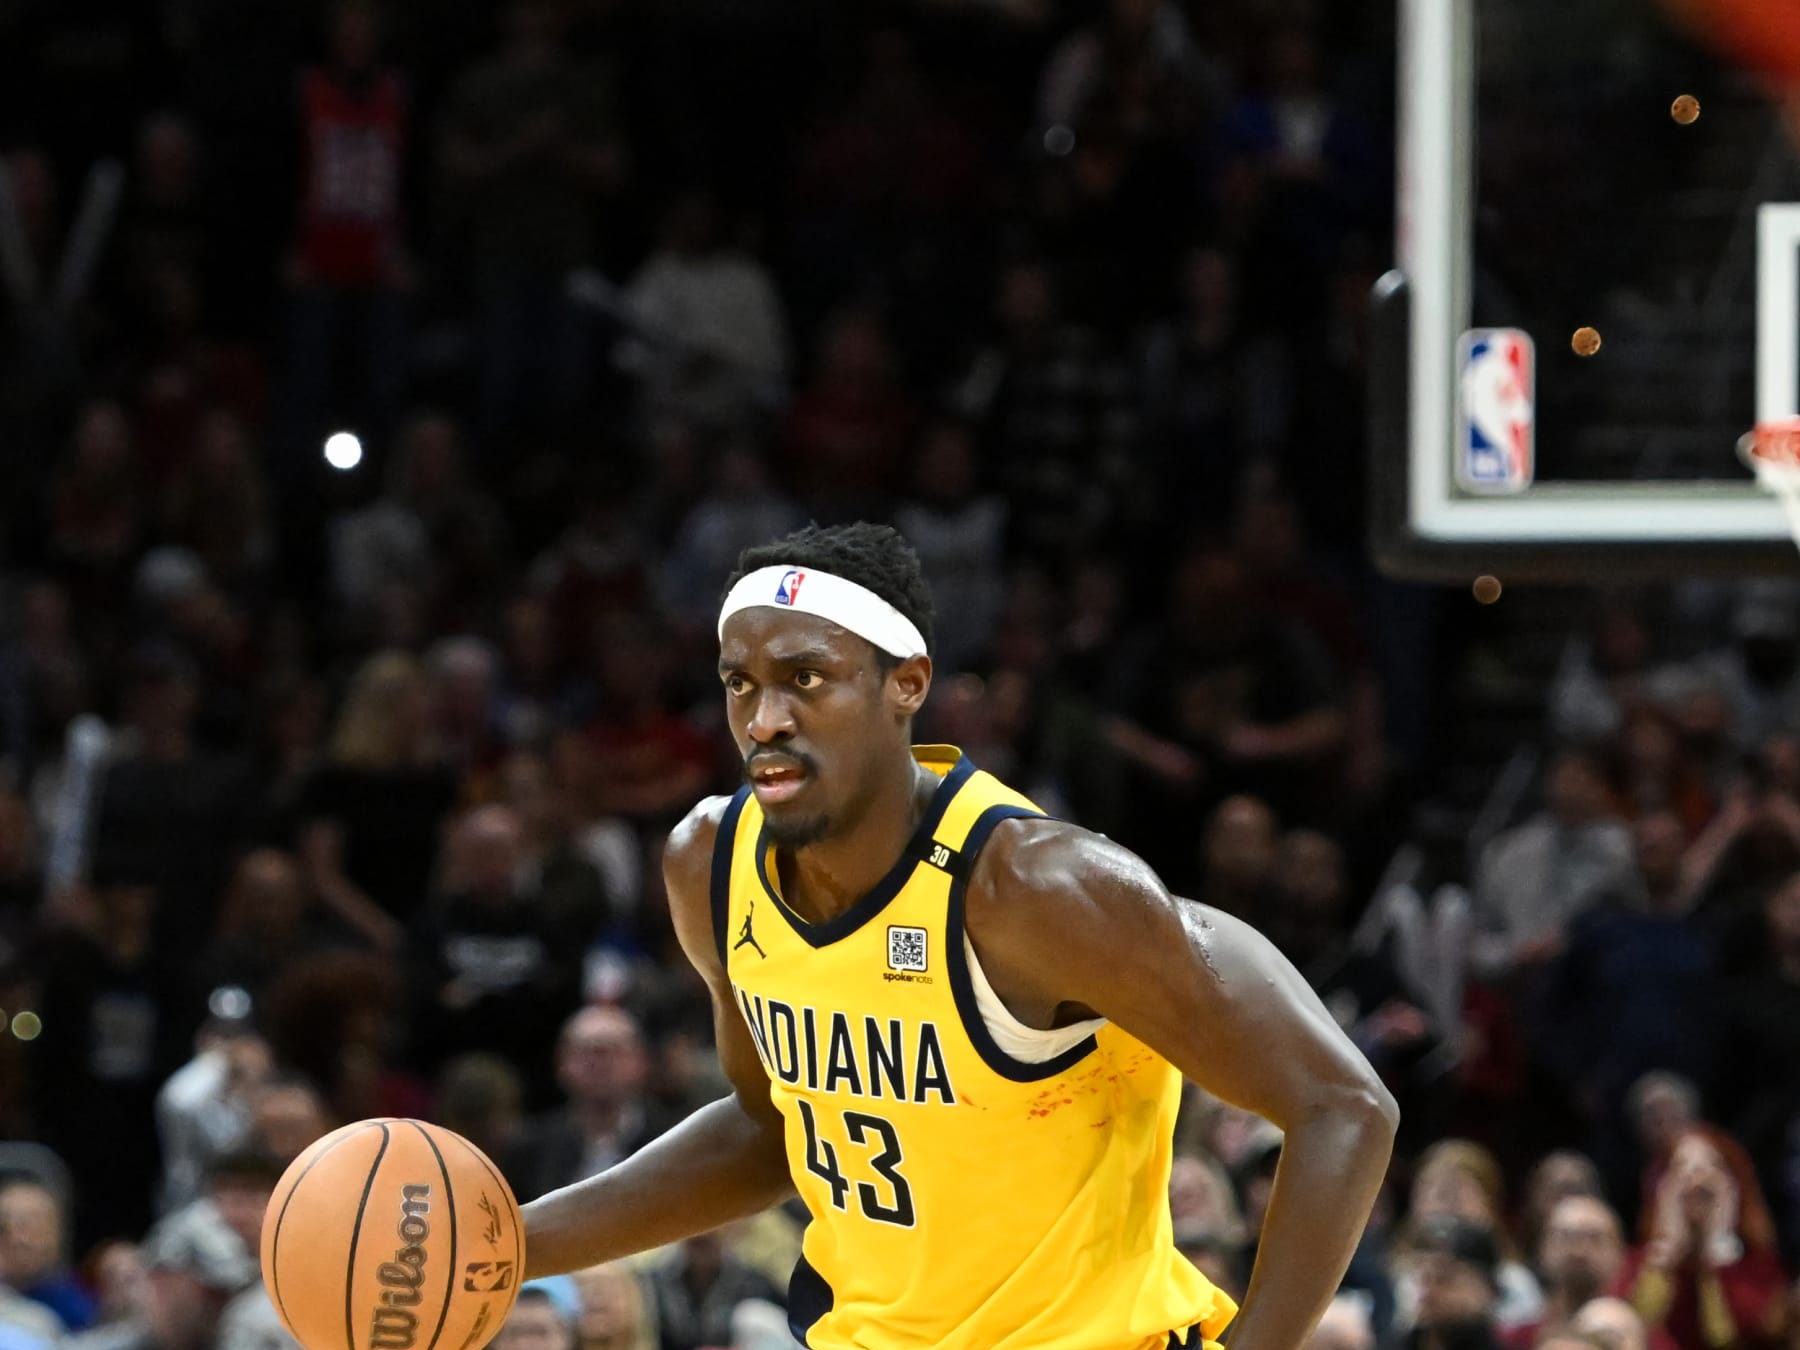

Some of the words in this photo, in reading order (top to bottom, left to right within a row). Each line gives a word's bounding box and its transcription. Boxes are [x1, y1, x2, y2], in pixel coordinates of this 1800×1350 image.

[929, 845, 951, 868] 30
[882, 971, 934, 985] spokenote
[733, 983, 956, 1105] NDIANA
[797, 1098, 916, 1228] 43
[369, 1183, 432, 1350] Wilson
